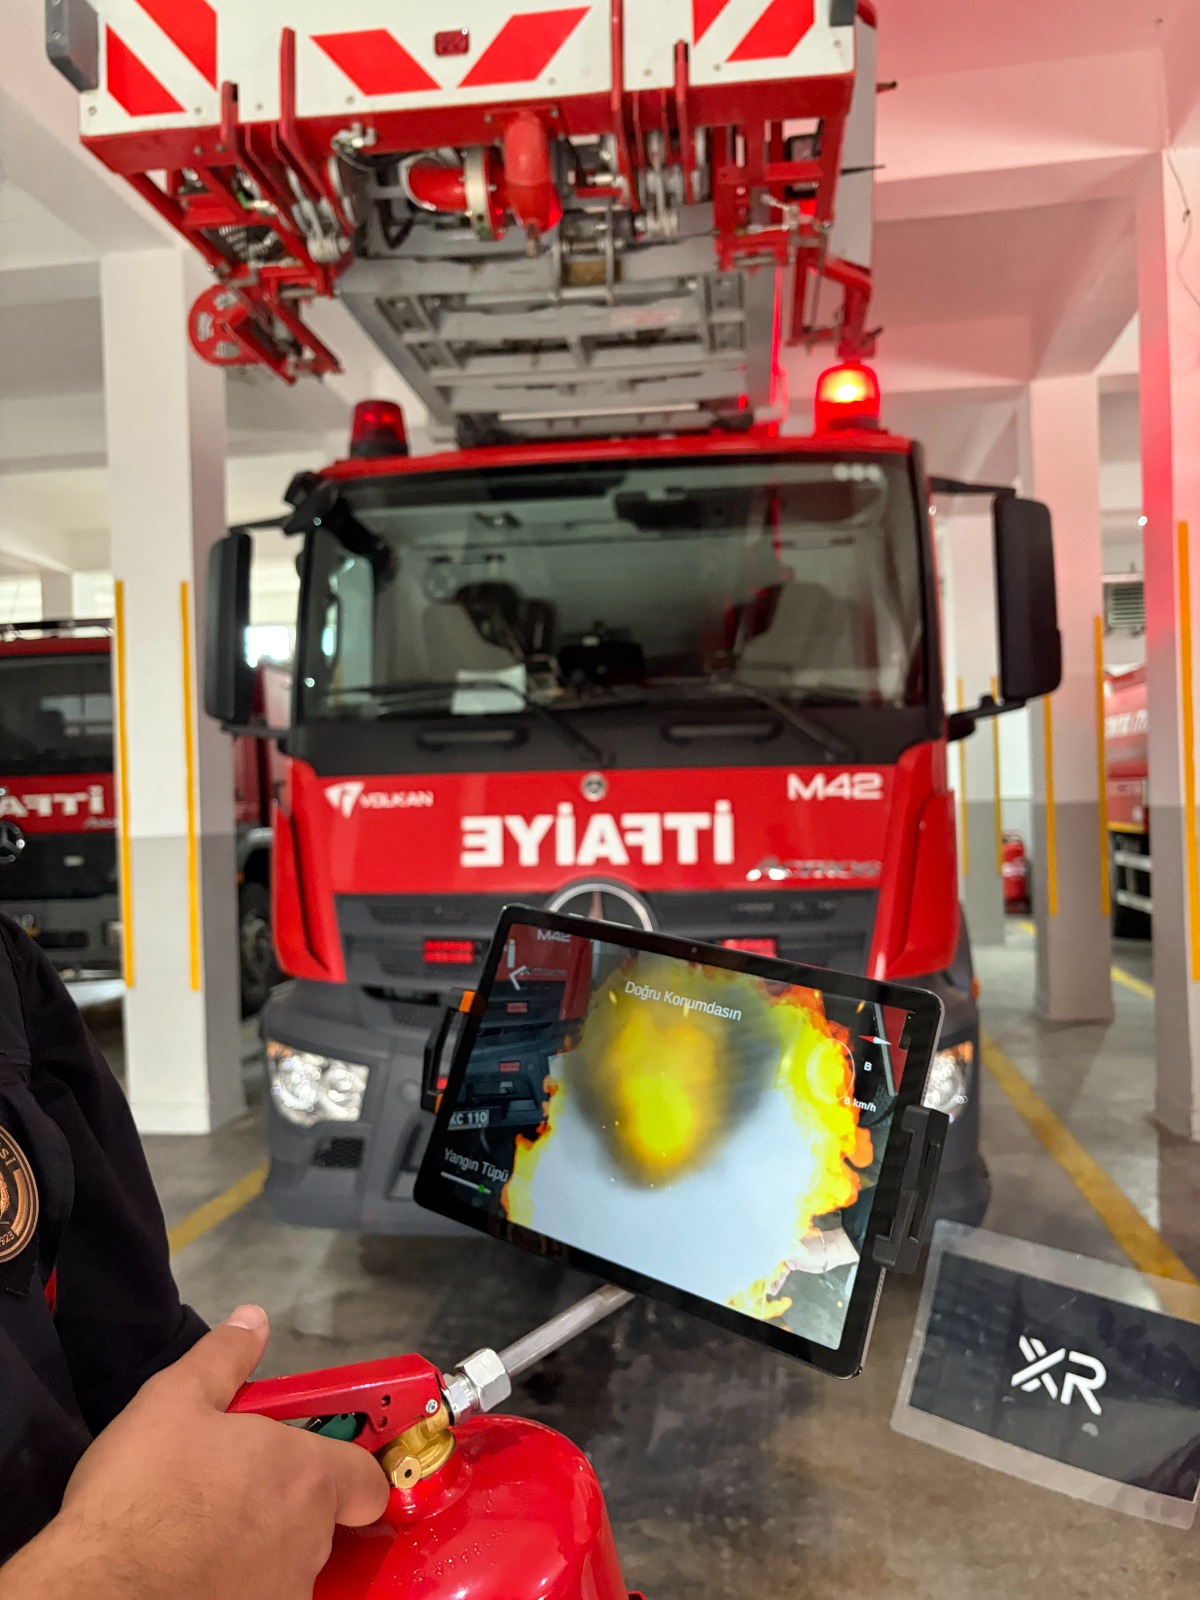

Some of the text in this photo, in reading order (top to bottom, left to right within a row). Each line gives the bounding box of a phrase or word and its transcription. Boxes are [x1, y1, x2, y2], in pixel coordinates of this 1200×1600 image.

[786, 772, 883, 801] M42
[625, 980, 742, 1021] Doğru Konumdasın
[852, 1099, 877, 1112] km/h
[1011, 1335, 1107, 1416] XR
